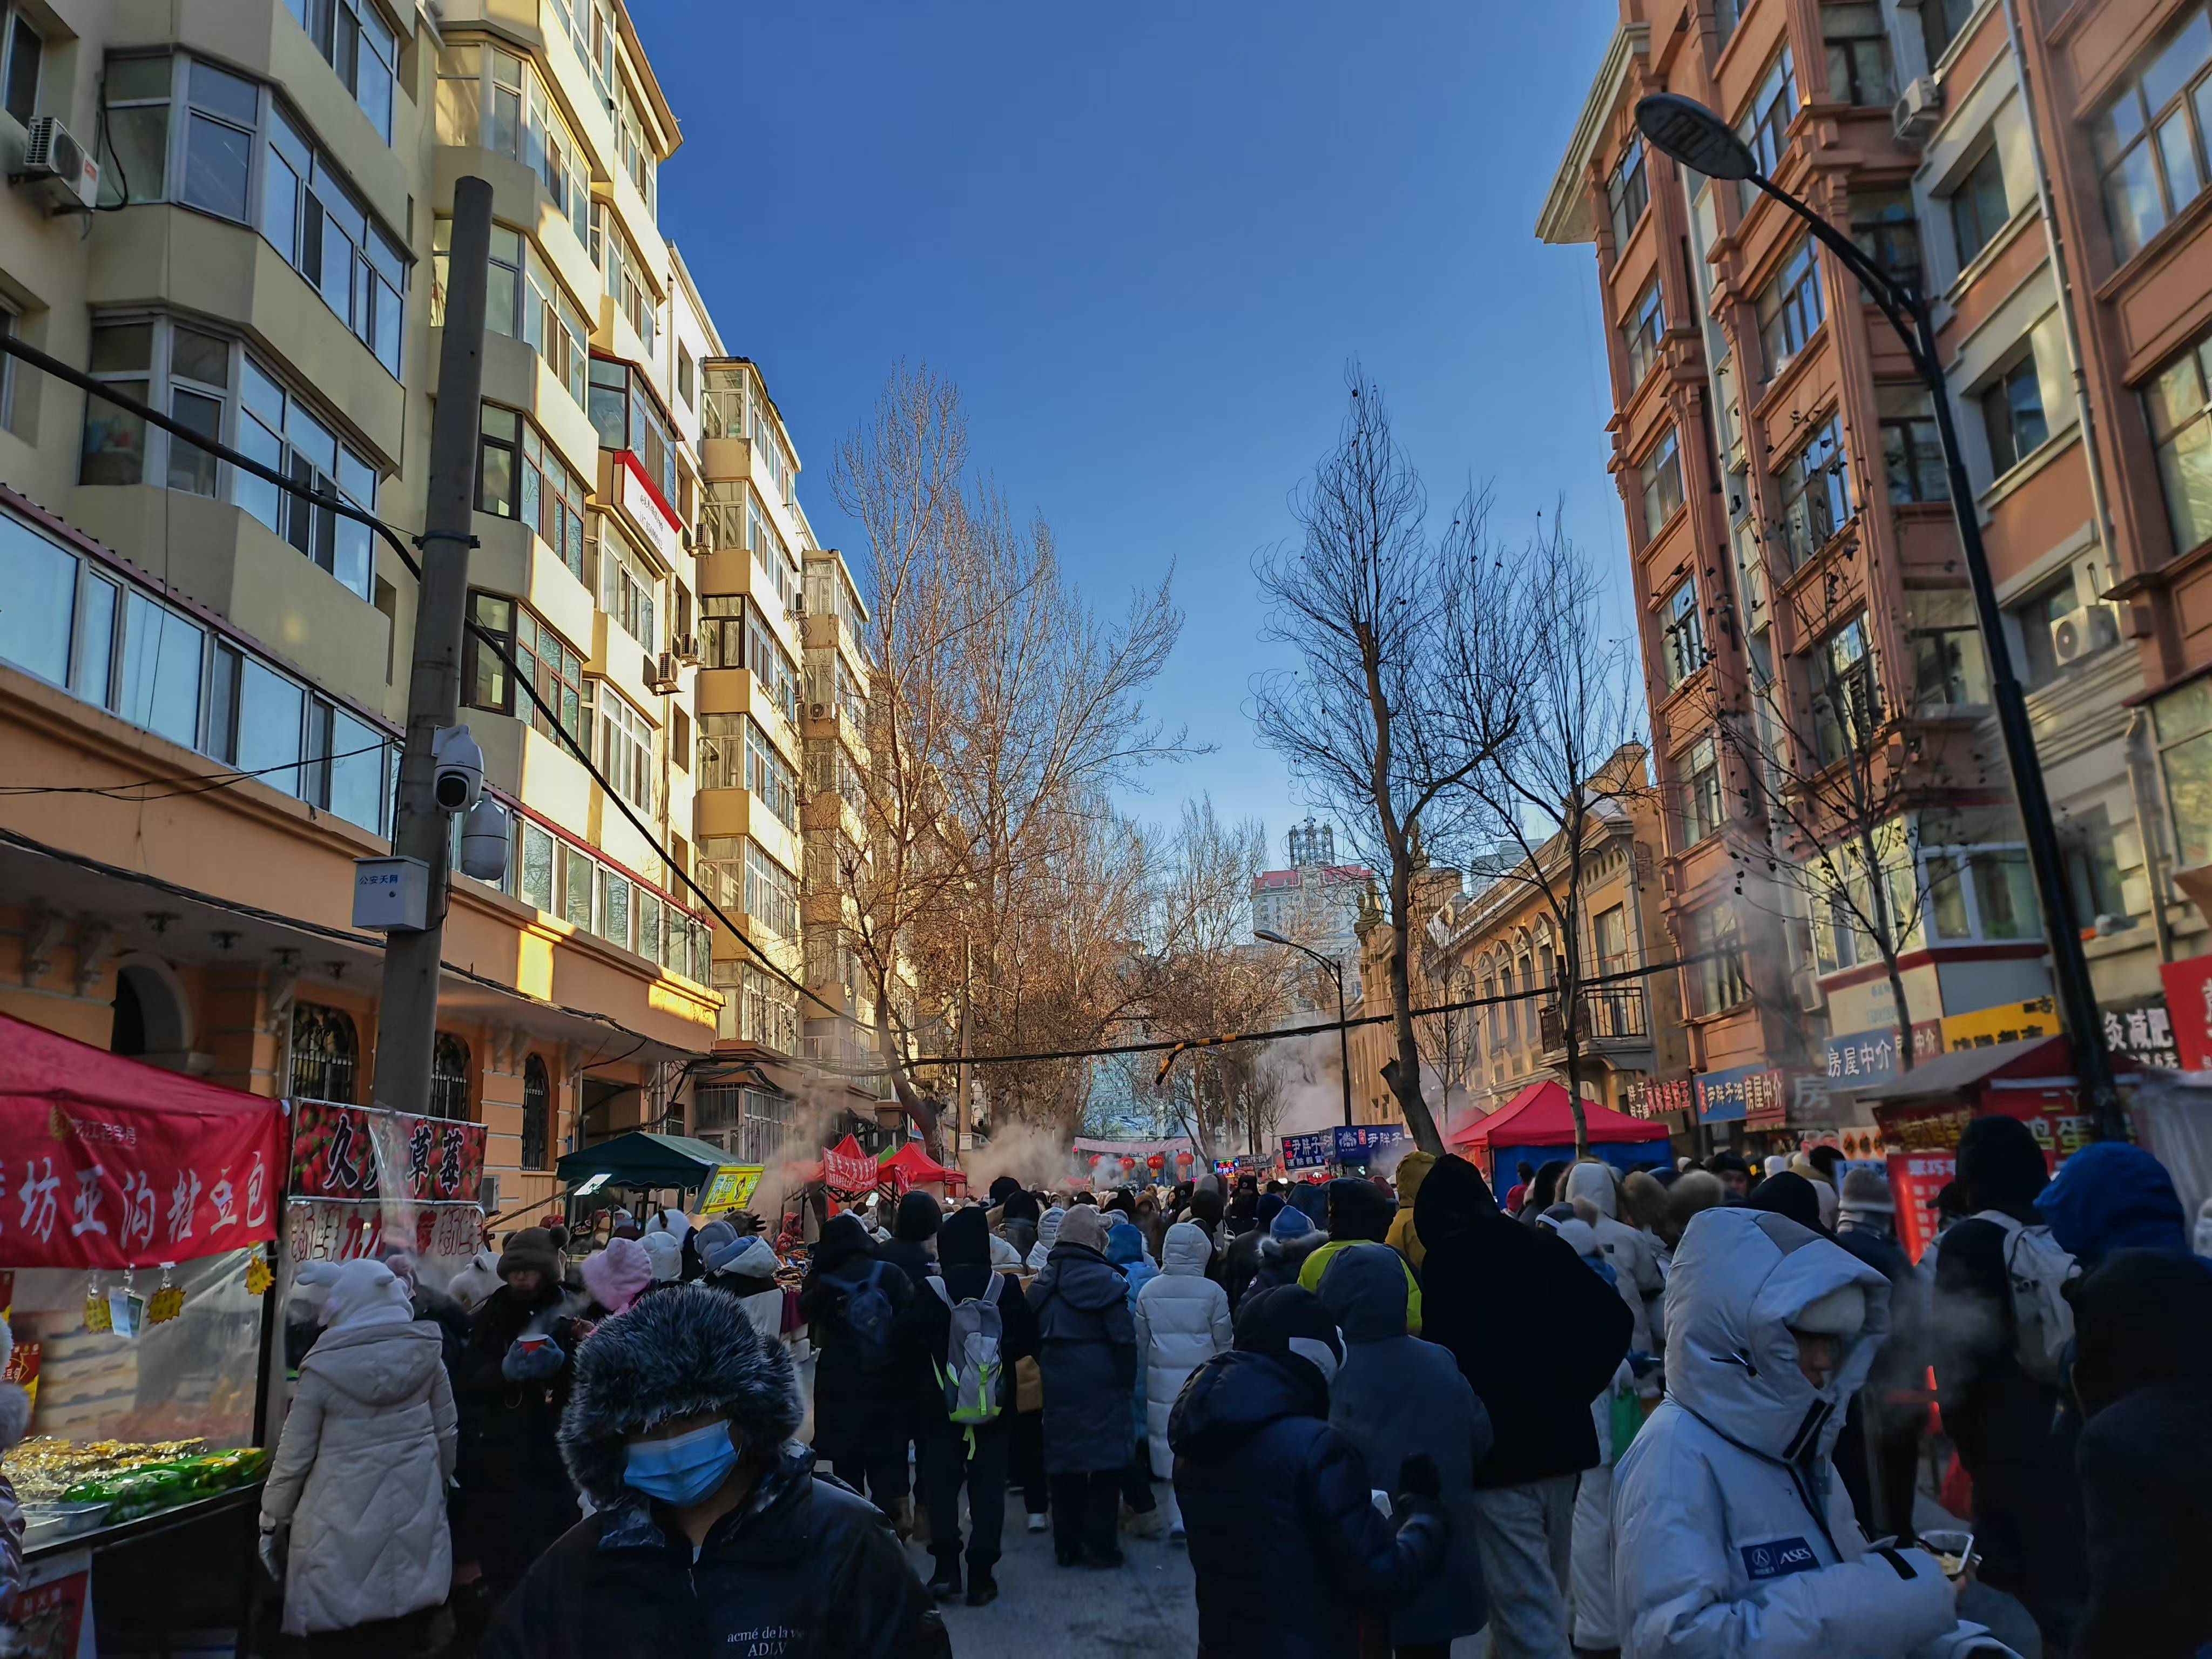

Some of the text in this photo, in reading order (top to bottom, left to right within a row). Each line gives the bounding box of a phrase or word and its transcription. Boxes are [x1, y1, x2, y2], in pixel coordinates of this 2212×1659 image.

[359, 874, 399, 885] 公安天网
[1827, 1039, 1892, 1078] 房屋中介
[1744, 1072, 1782, 1111] 房屋中介
[1292, 1136, 1320, 1158] 尹胖子
[1367, 1131, 1402, 1148] 尹胖子
[0, 1151, 267, 1250] 坊亚沟粘豆包
[727, 1628, 759, 1642] acmé
[762, 1626, 776, 1639] de
[779, 1626, 788, 1638] la
[747, 1642, 787, 1657] ADLV
